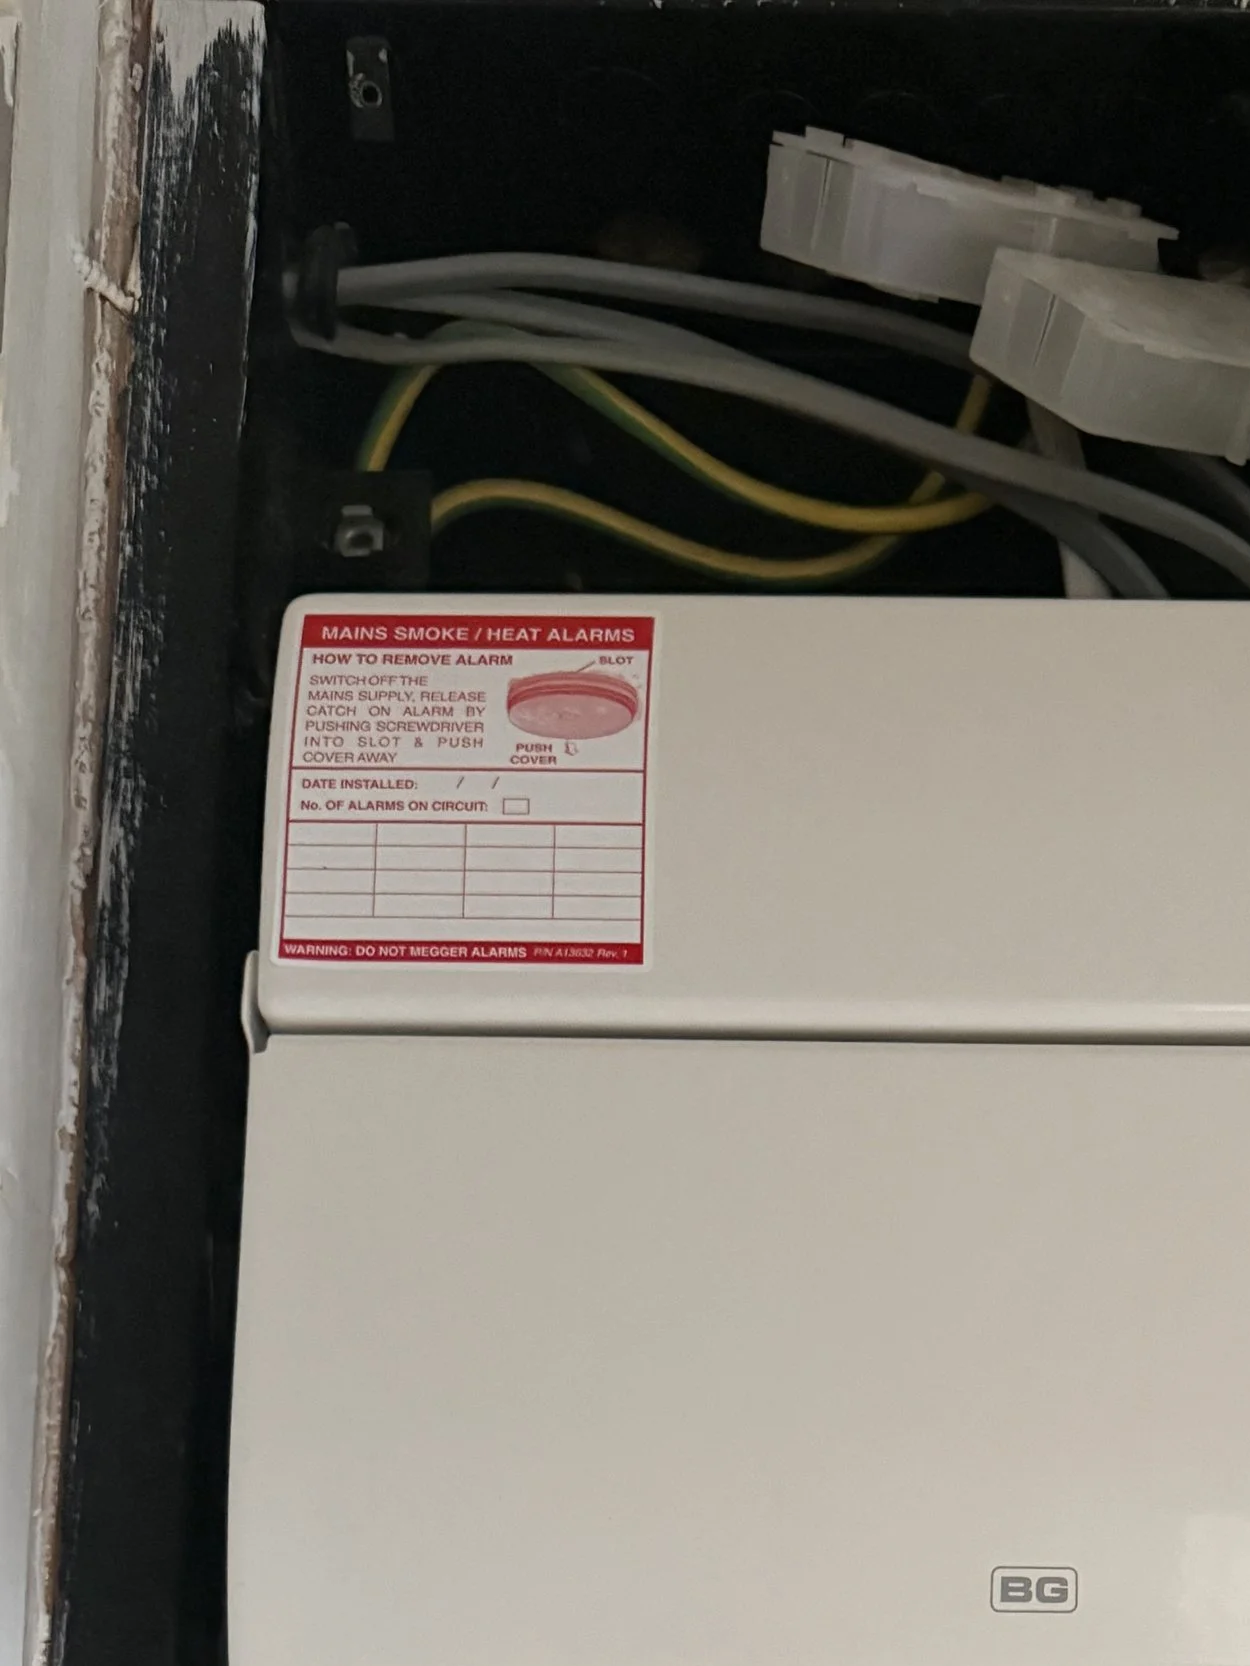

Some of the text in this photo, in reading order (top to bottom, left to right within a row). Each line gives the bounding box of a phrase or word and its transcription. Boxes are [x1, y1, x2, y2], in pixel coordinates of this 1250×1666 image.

[322, 627, 635, 642] MAINS SMOKE / HEAT ALARMS
[313, 654, 513, 666] HOW TO REMOVE ALARM
[600, 656, 634, 665] SLOT
[308, 690, 354, 701] MAINS
[420, 691, 486, 702] RELEASE
[306, 705, 486, 717] CATCH ON ALARM BY
[305, 720, 484, 733] PUSHING SCREWDRIVER
[304, 736, 484, 748] INTO SLOT & PUSH
[516, 744, 552, 753] PUSH
[302, 751, 398, 763] COVER AWAY
[510, 755, 557, 765] COVER
[302, 779, 418, 790] DATE INSTALLED:
[301, 800, 488, 812] No. OF ALARMS ON CIRCUIT:
[283, 944, 527, 958] WARNING: DO NOT MEGGER ALARMS
[1000, 1576, 1068, 1603] BG
